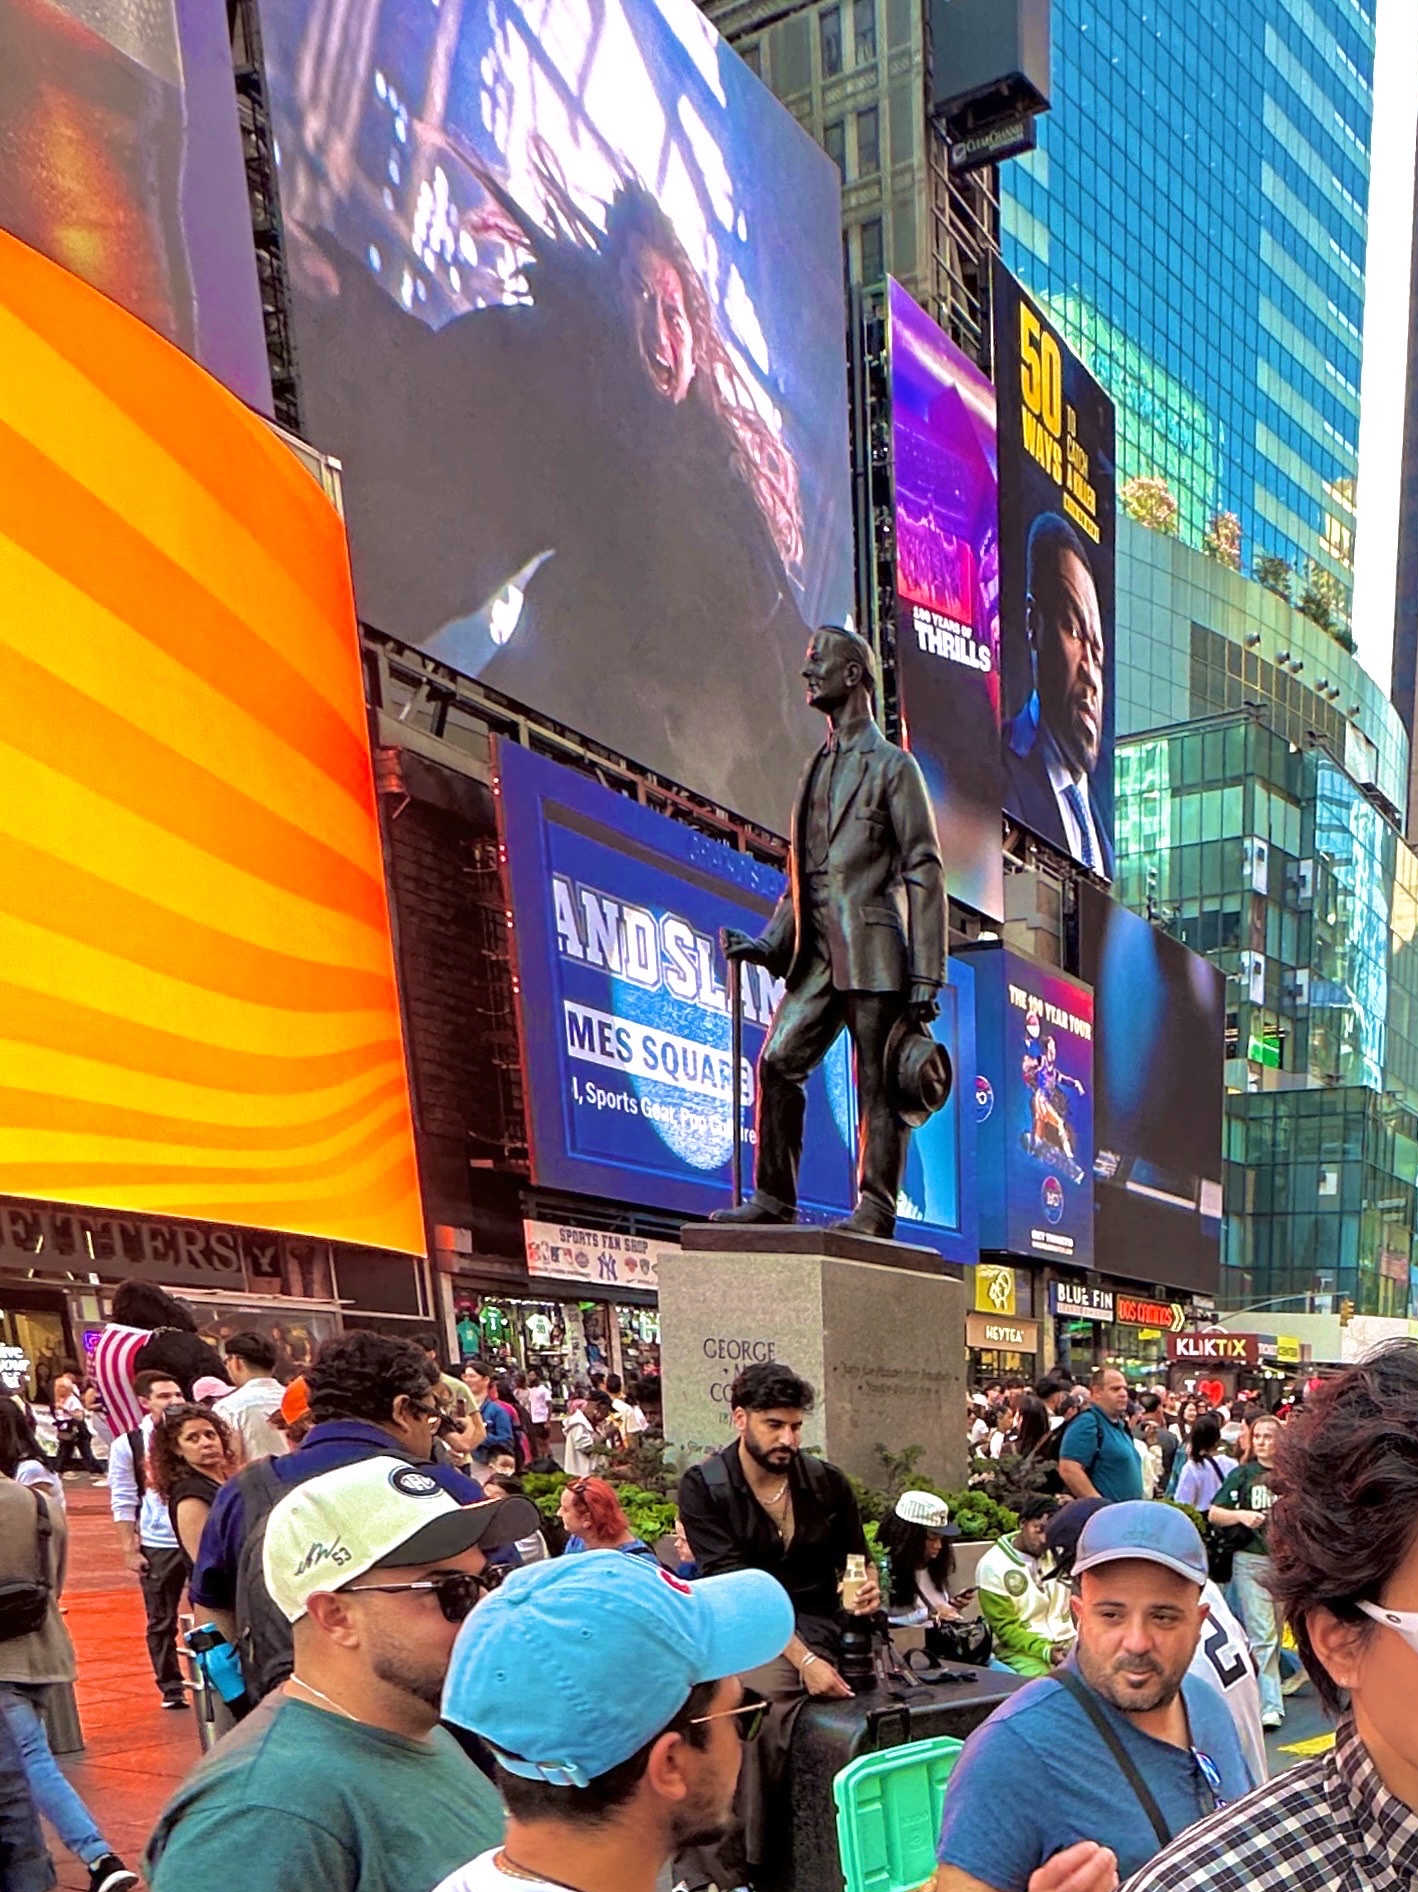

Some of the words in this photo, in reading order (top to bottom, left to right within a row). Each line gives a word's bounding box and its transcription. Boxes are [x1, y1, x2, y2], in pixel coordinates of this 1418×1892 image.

[1020, 300, 1062, 438] 50
[1021, 404, 1063, 486] WAYS
[913, 618, 991, 672] THRILLS
[1009, 984, 1027, 1010] THE
[1045, 1002, 1069, 1030] YEAR
[1069, 1014, 1092, 1041] TOUR
[568, 1010, 633, 1063] MES
[586, 1081, 638, 1115] Sports
[559, 1227, 599, 1247] SPORTS
[601, 1232, 621, 1250] FAN
[624, 1238, 649, 1254] SHOP
[1057, 1283, 1089, 1305] BLUE
[1092, 1289, 1113, 1309] FIN
[703, 1337, 775, 1361] GEORGE
[985, 1325, 1022, 1343] HEYTEA
[1176, 1337, 1247, 1357] KLIKTIX
[331, 1546, 352, 1566] 53
